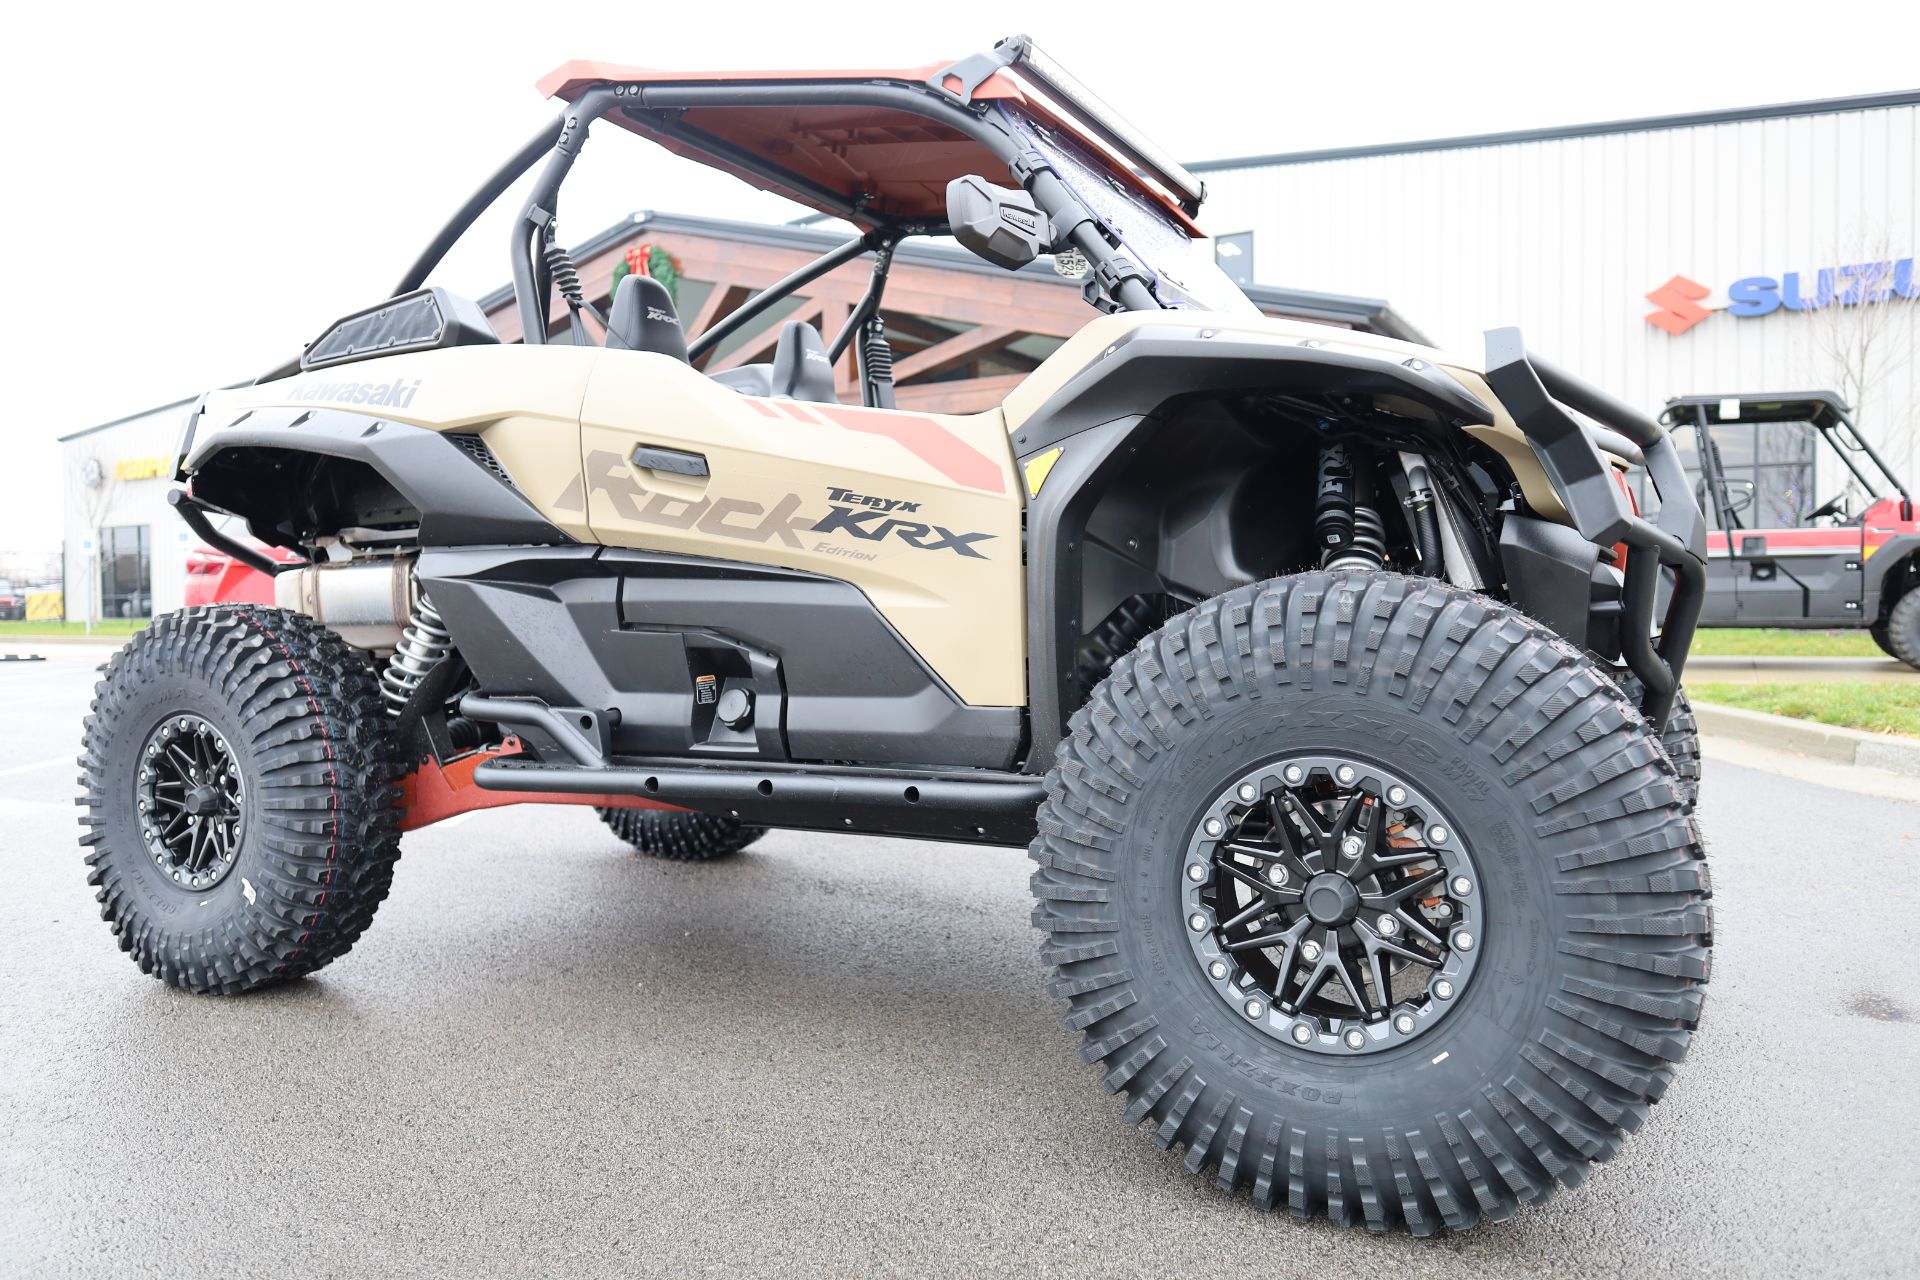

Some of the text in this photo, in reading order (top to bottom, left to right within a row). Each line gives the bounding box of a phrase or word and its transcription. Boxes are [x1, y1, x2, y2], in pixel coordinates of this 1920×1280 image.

[286, 378, 423, 409] Kawasaki
[552, 449, 818, 549] Rock
[810, 504, 1000, 561] KRX
[1221, 710, 1442, 766] MAXXIS
